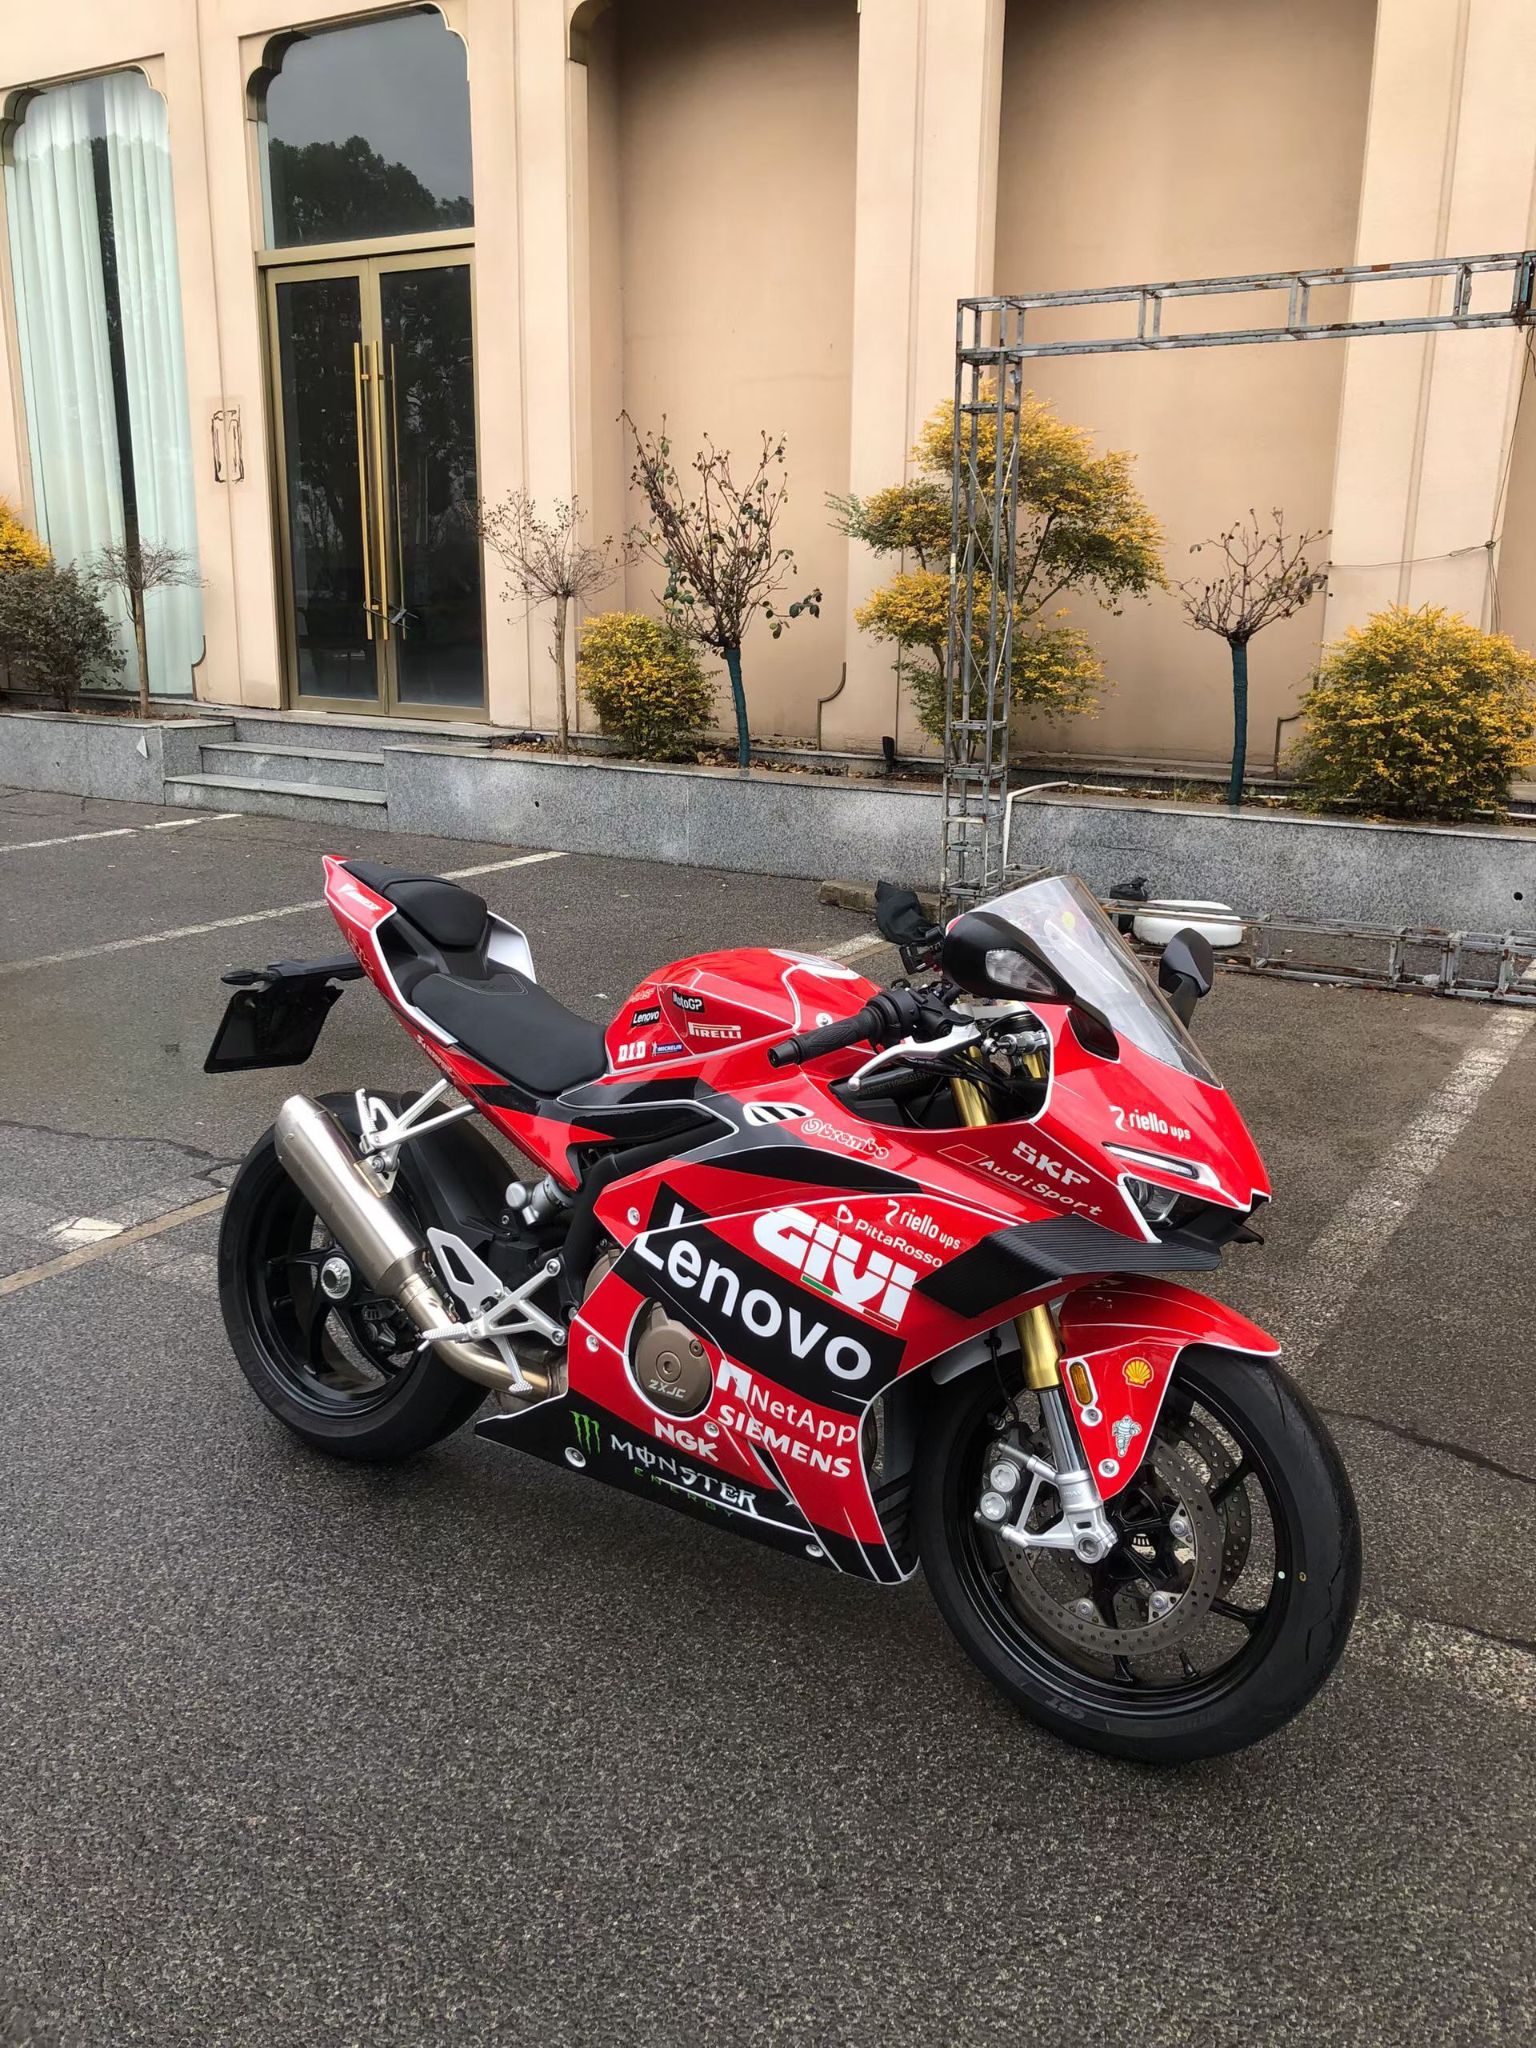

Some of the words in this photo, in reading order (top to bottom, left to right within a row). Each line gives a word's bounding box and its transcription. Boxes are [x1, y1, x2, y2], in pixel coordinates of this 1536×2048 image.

[632, 1011, 660, 1025] Lenovo
[688, 1022, 742, 1040] PIRELLI
[817, 1123, 889, 1160] brembo
[1129, 1110, 1168, 1134] riello
[1169, 1126, 1191, 1142] ups
[1012, 1141, 1091, 1187] SKF
[978, 1159, 1032, 1188] Audi
[1031, 1181, 1103, 1217] Sport
[855, 1218, 943, 1268] PittaRosso
[899, 1208, 940, 1239] riello
[939, 1232, 961, 1250] ups
[633, 1202, 872, 1381] Lenovo
[648, 1379, 687, 1399] ZXJC
[750, 1385, 856, 1443] NetApp
[654, 1418, 720, 1463] NGK
[718, 1405, 853, 1478] SIEMENS
[610, 1434, 758, 1516] MONSTER
